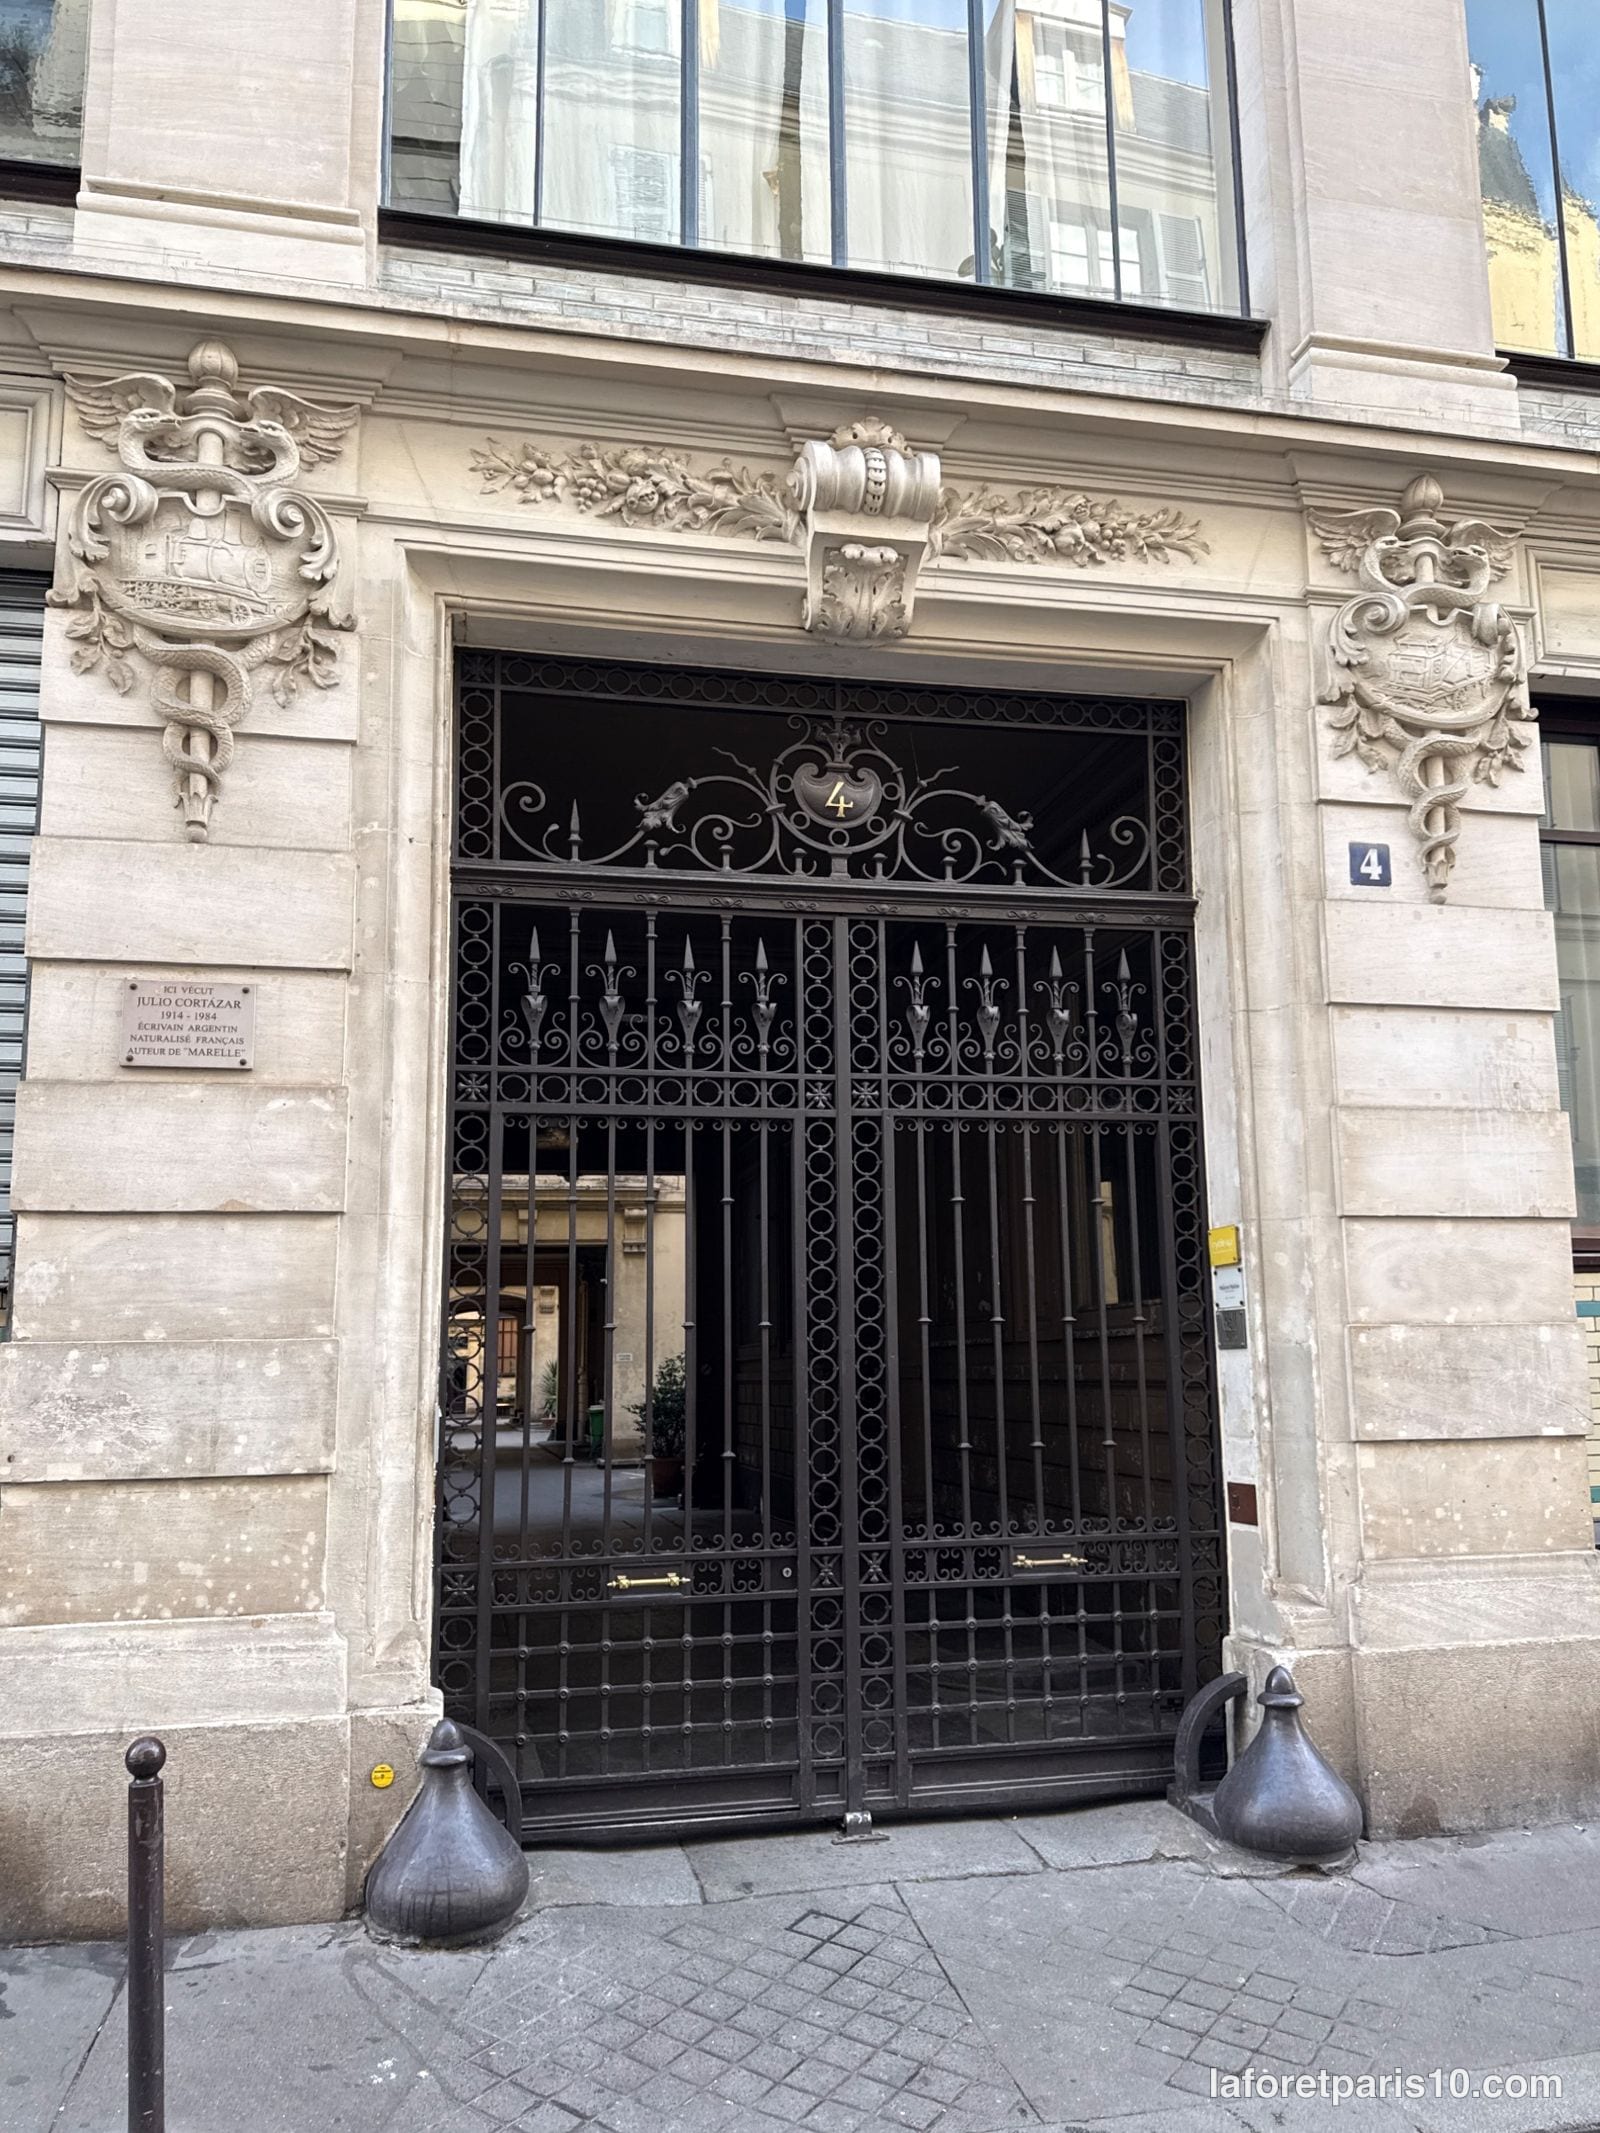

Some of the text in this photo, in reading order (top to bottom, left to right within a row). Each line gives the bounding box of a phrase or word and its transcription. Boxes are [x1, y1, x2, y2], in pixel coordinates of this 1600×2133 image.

[825, 781, 853, 818] 4
[1360, 848, 1382, 880] 4
[163, 986, 214, 995] ICI VÉCUT
[137, 996, 241, 1009] JULIO CORTÁZAR
[161, 1011, 183, 1019] 1914
[195, 1012, 217, 1020] 1984
[138, 1022, 238, 1033] ÉCRIVAIN ARGENTIN
[130, 1034, 244, 1045] NATURALISÉ FRANÇAIS
[127, 1047, 165, 1055] AUTEUR
